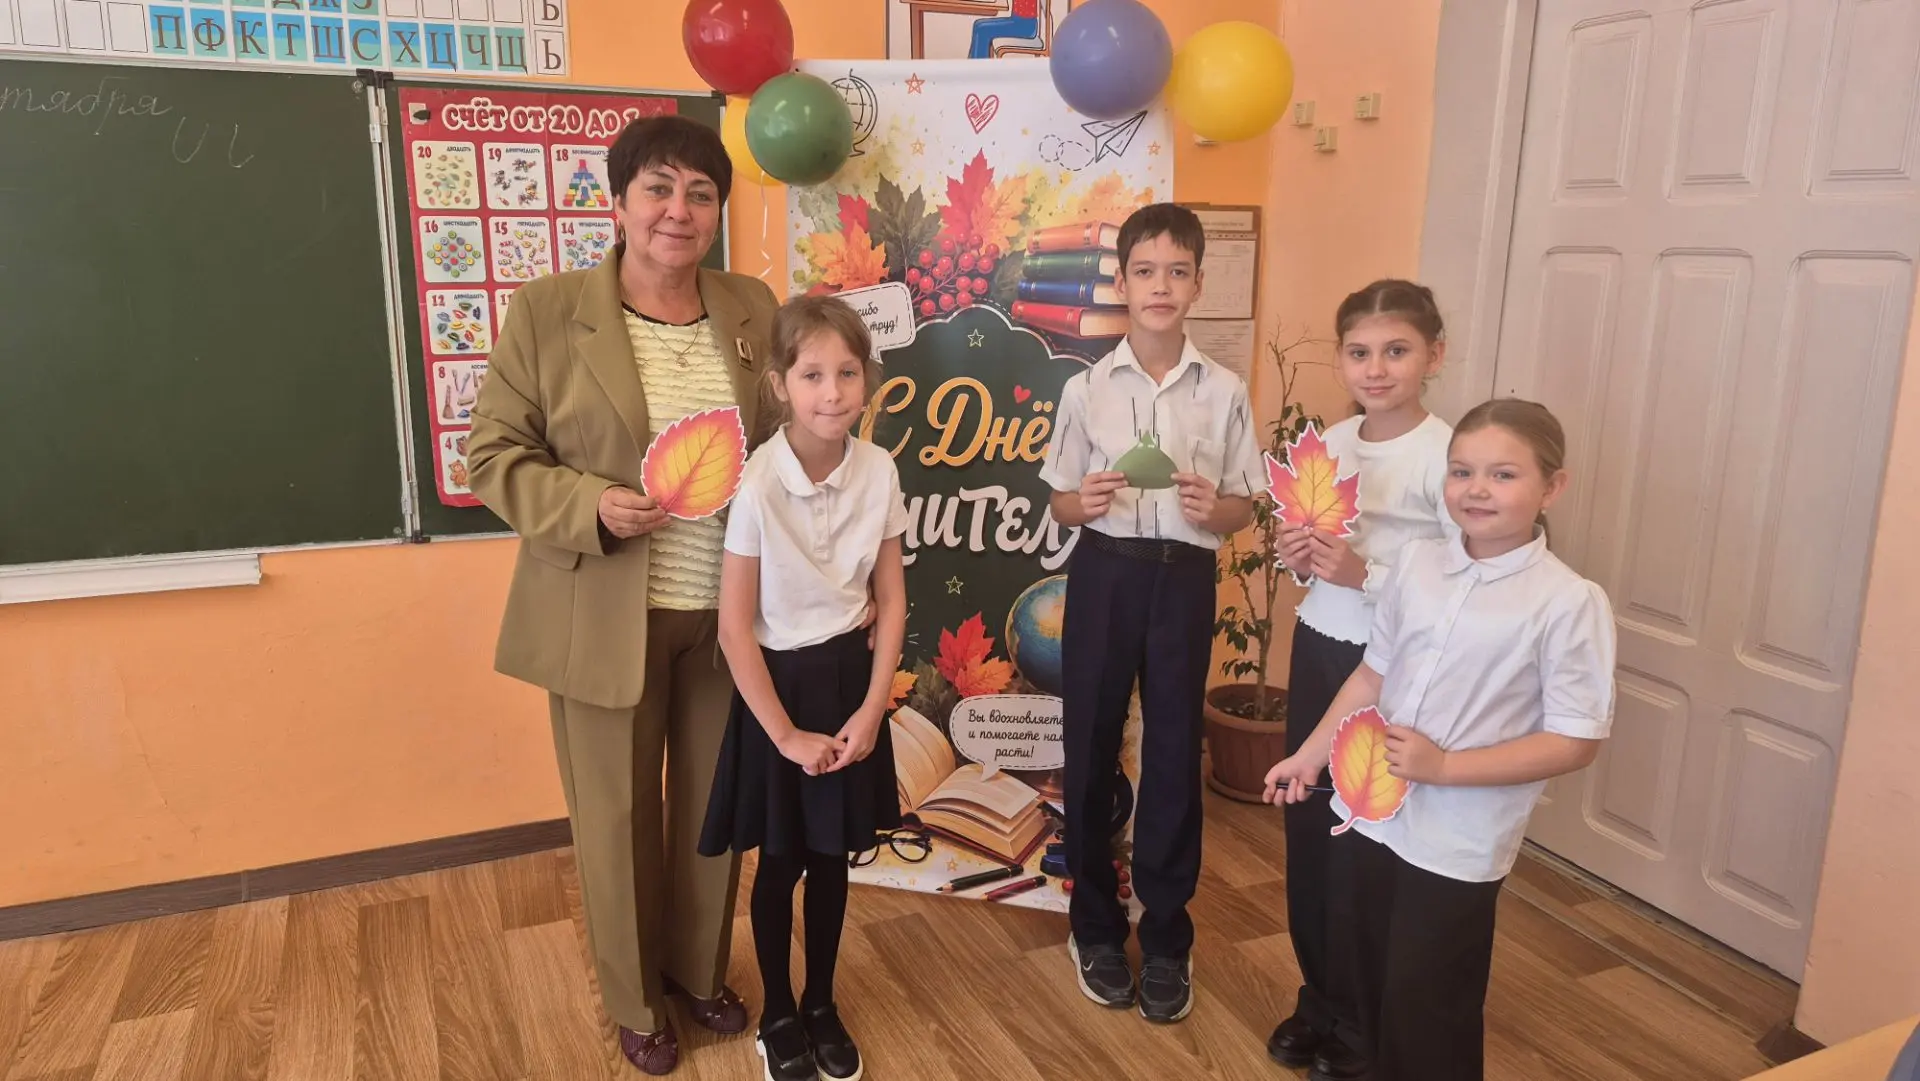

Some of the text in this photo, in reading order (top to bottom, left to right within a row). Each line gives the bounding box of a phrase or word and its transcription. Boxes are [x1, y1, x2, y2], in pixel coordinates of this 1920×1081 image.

[154, 15, 562, 76] П Ф К Т Ш С Х Ц Ч Щ Ь
[0, 76, 173, 136] тября
[442, 97, 620, 138] СЧЁТ ОТ 20 ДО
[417, 146, 432, 159] 20
[488, 148, 502, 162] 19
[555, 149, 569, 162] 18
[424, 220, 439, 233] 16
[494, 221, 508, 235] 15
[561, 222, 575, 235] 14
[431, 294, 446, 307] 12
[857, 301, 879, 317] сибо
[870, 314, 898, 335] труд!
[438, 366, 446, 379] 8
[918, 376, 1053, 466] Днё
[445, 436, 452, 450] 4
[900, 485, 1081, 571] ЧИТЕЛ
[968, 708, 1063, 725] Вы вдохновляете
[968, 730, 975, 739] и
[979, 730, 1040, 741] помогаете
[994, 745, 1035, 761] расти!
